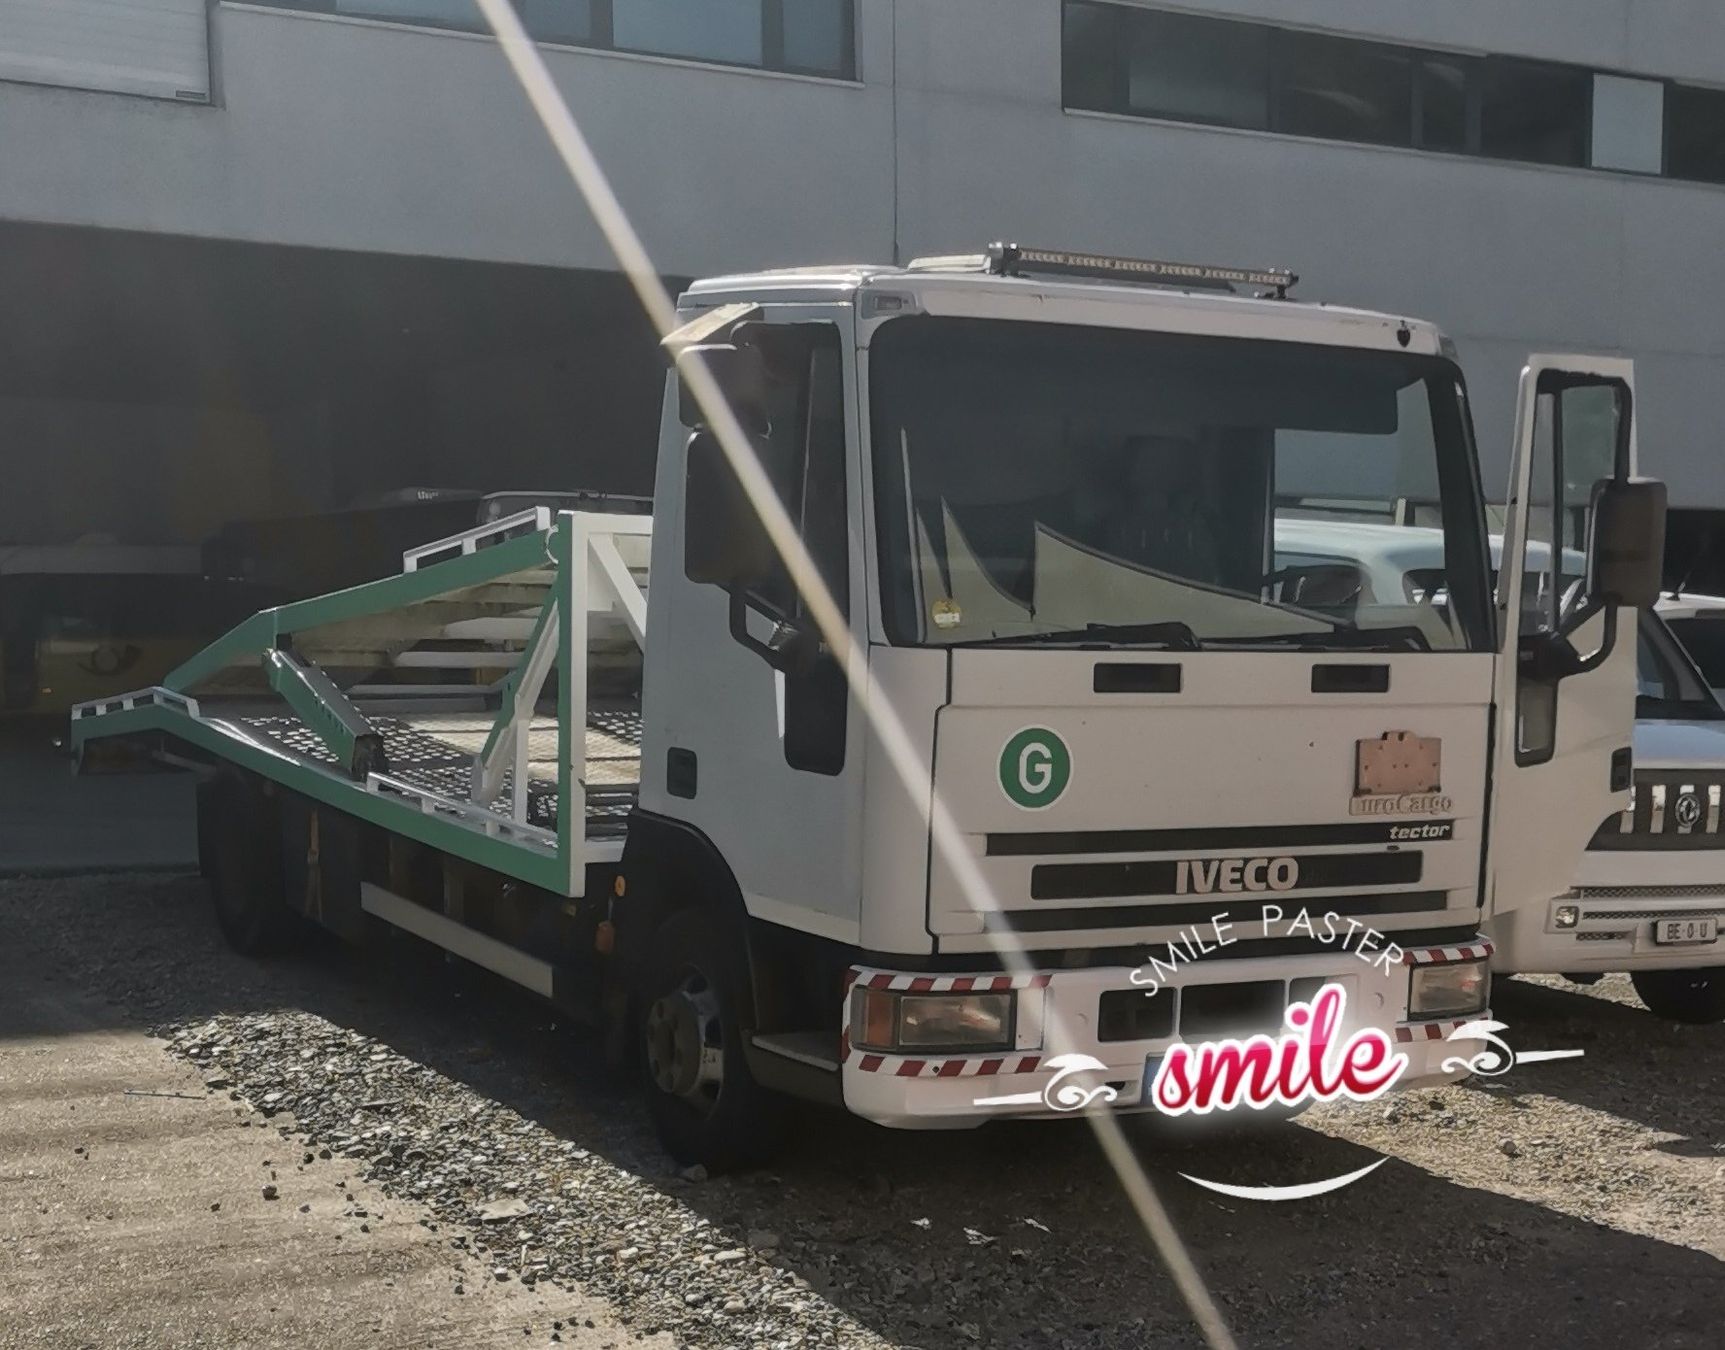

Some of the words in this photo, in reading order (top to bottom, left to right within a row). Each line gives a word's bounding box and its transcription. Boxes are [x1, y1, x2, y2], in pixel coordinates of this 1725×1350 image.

[1018, 741, 1053, 795] G
[1389, 824, 1451, 839] tector
[1175, 856, 1299, 894] IVECO
